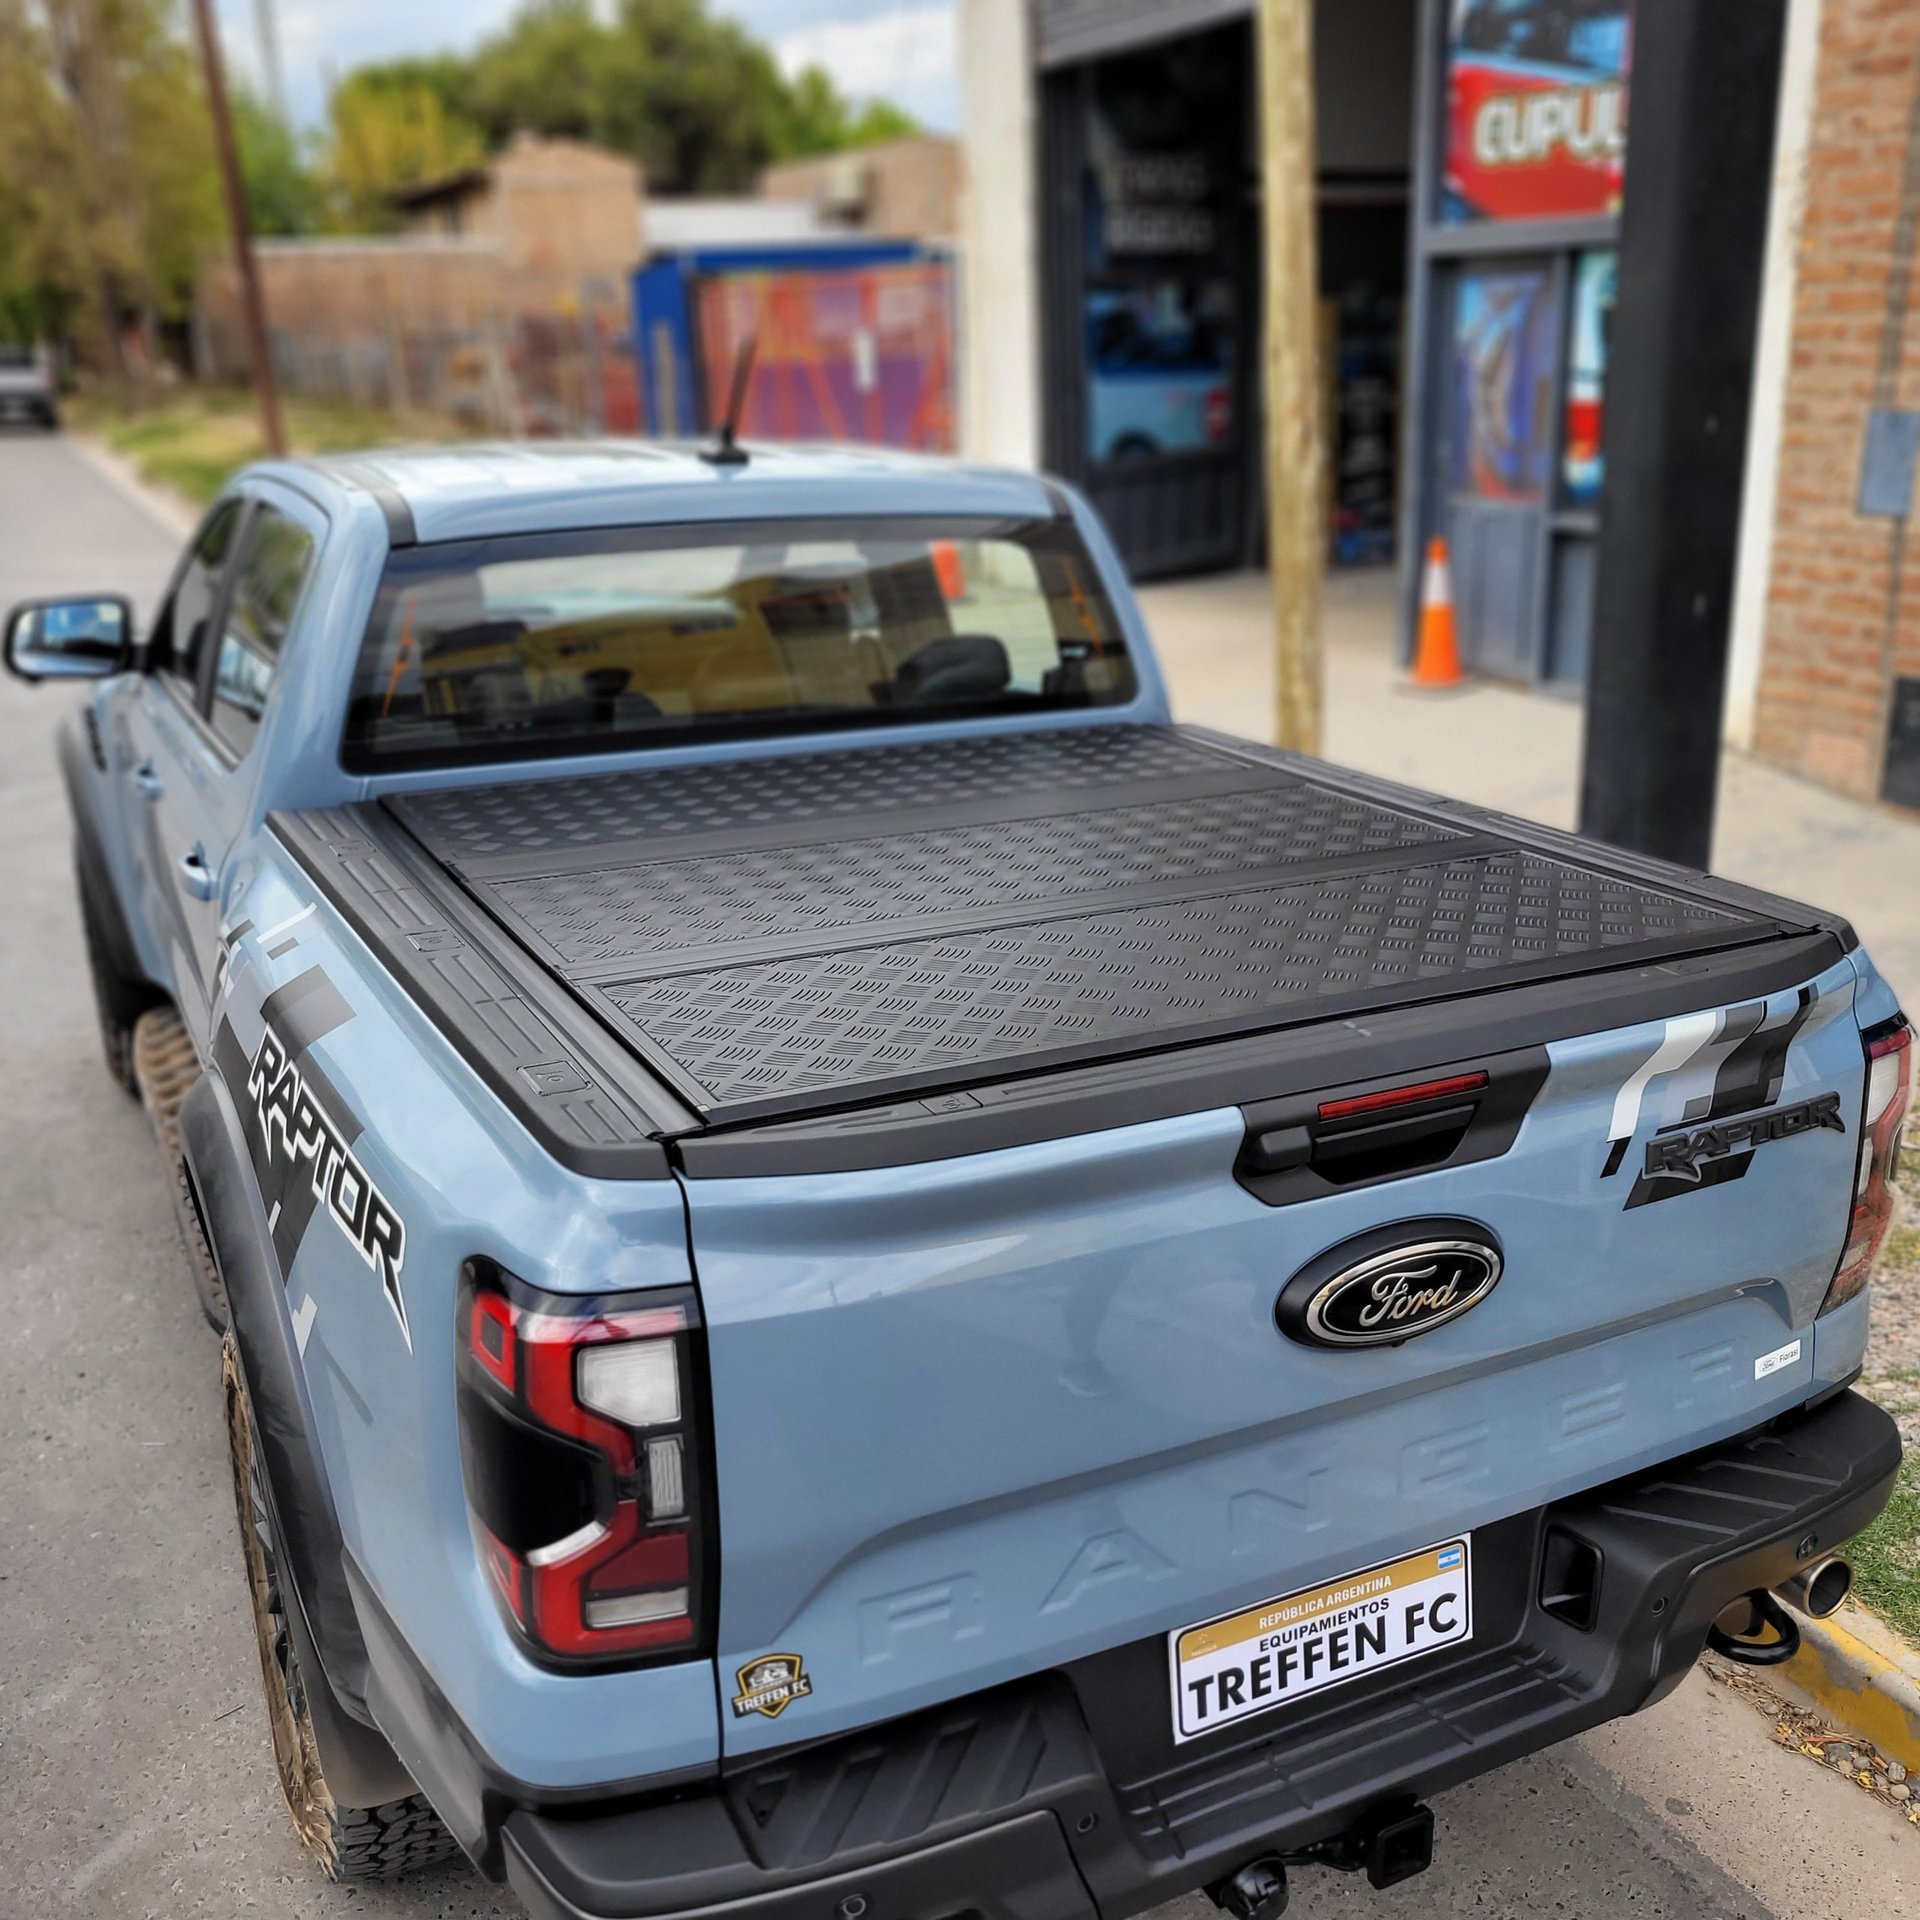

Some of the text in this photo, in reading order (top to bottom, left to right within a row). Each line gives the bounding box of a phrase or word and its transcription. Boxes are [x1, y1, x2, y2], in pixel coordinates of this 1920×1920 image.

[1642, 1090, 1845, 1183] RAPTOR
[248, 1022, 413, 1356] RAPTOR
[1359, 1264, 1462, 1327] Ford
[1259, 1575, 1393, 1630] REPÚBLICA ARGENTINA
[1259, 1597, 1390, 1652] EQUIPAMIENTOS
[1188, 1592, 1459, 1720] TREFFEN FC
[735, 1678, 808, 1713] TREFFEN FC
